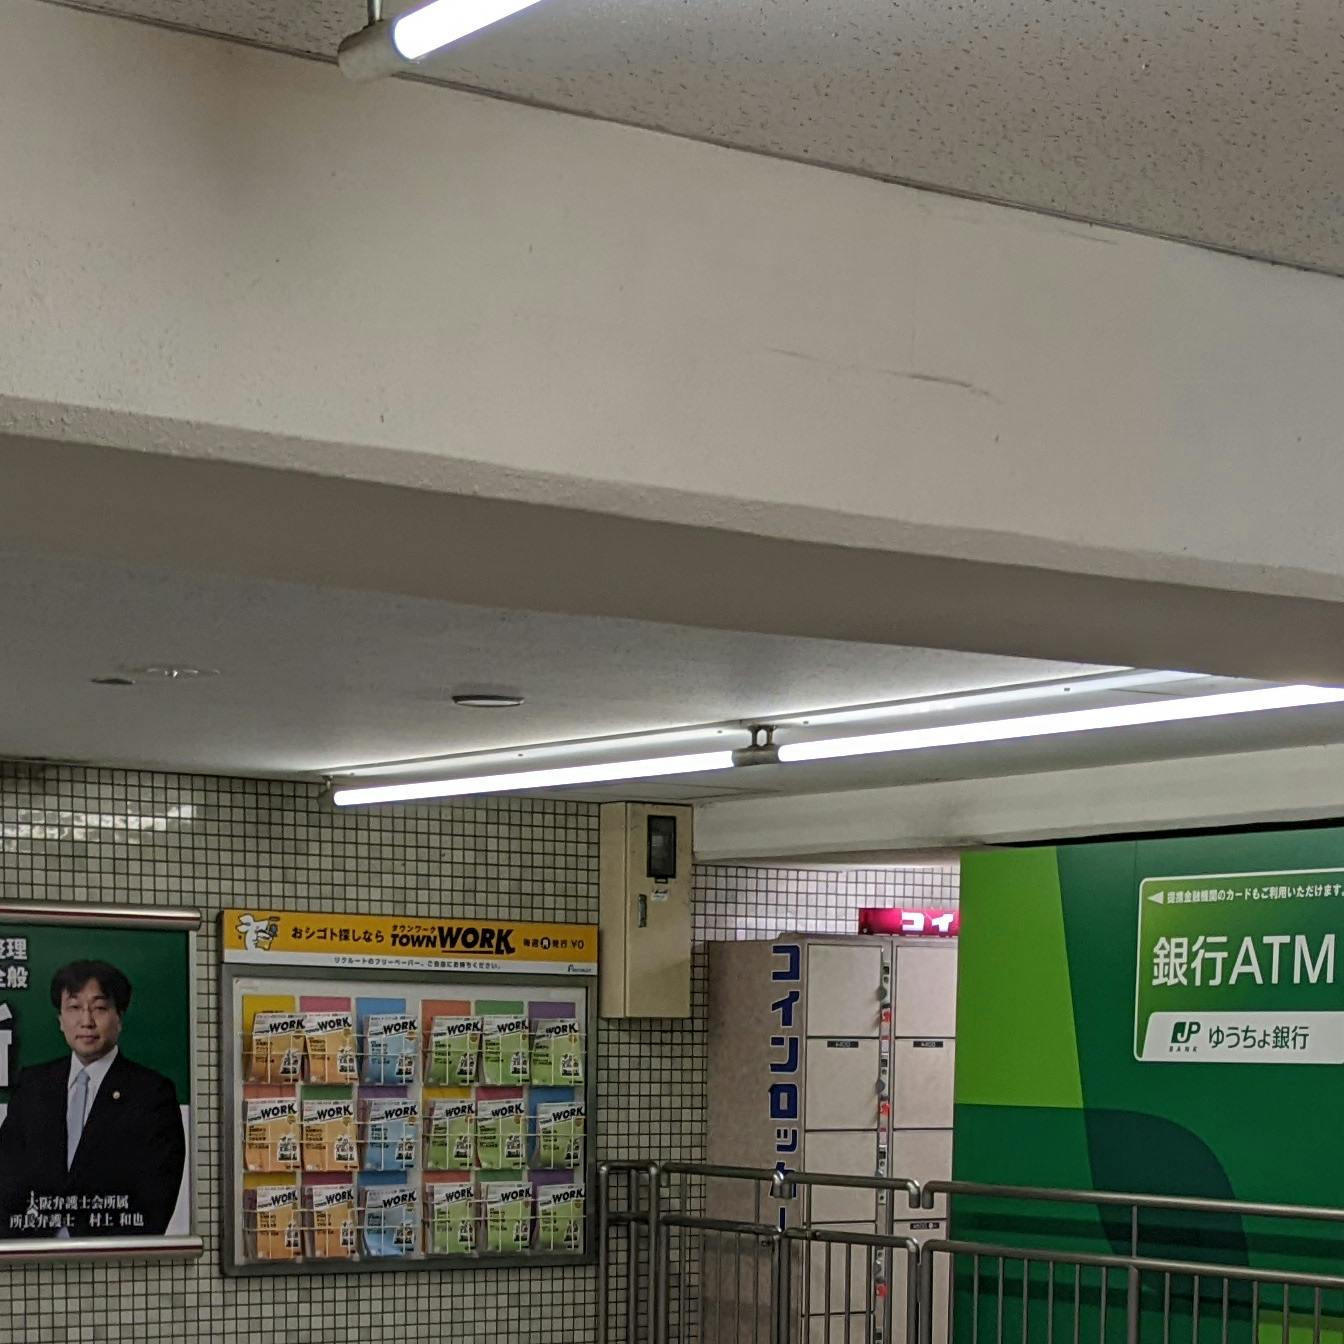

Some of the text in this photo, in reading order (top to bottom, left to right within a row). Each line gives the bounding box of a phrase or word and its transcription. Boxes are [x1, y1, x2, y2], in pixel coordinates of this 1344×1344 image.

[291, 926, 385, 944] おシゴト探しなら
[1151, 933, 1336, 987] 銀行ATM
[1208, 1025, 1309, 1049] ゆうちょ銀行
